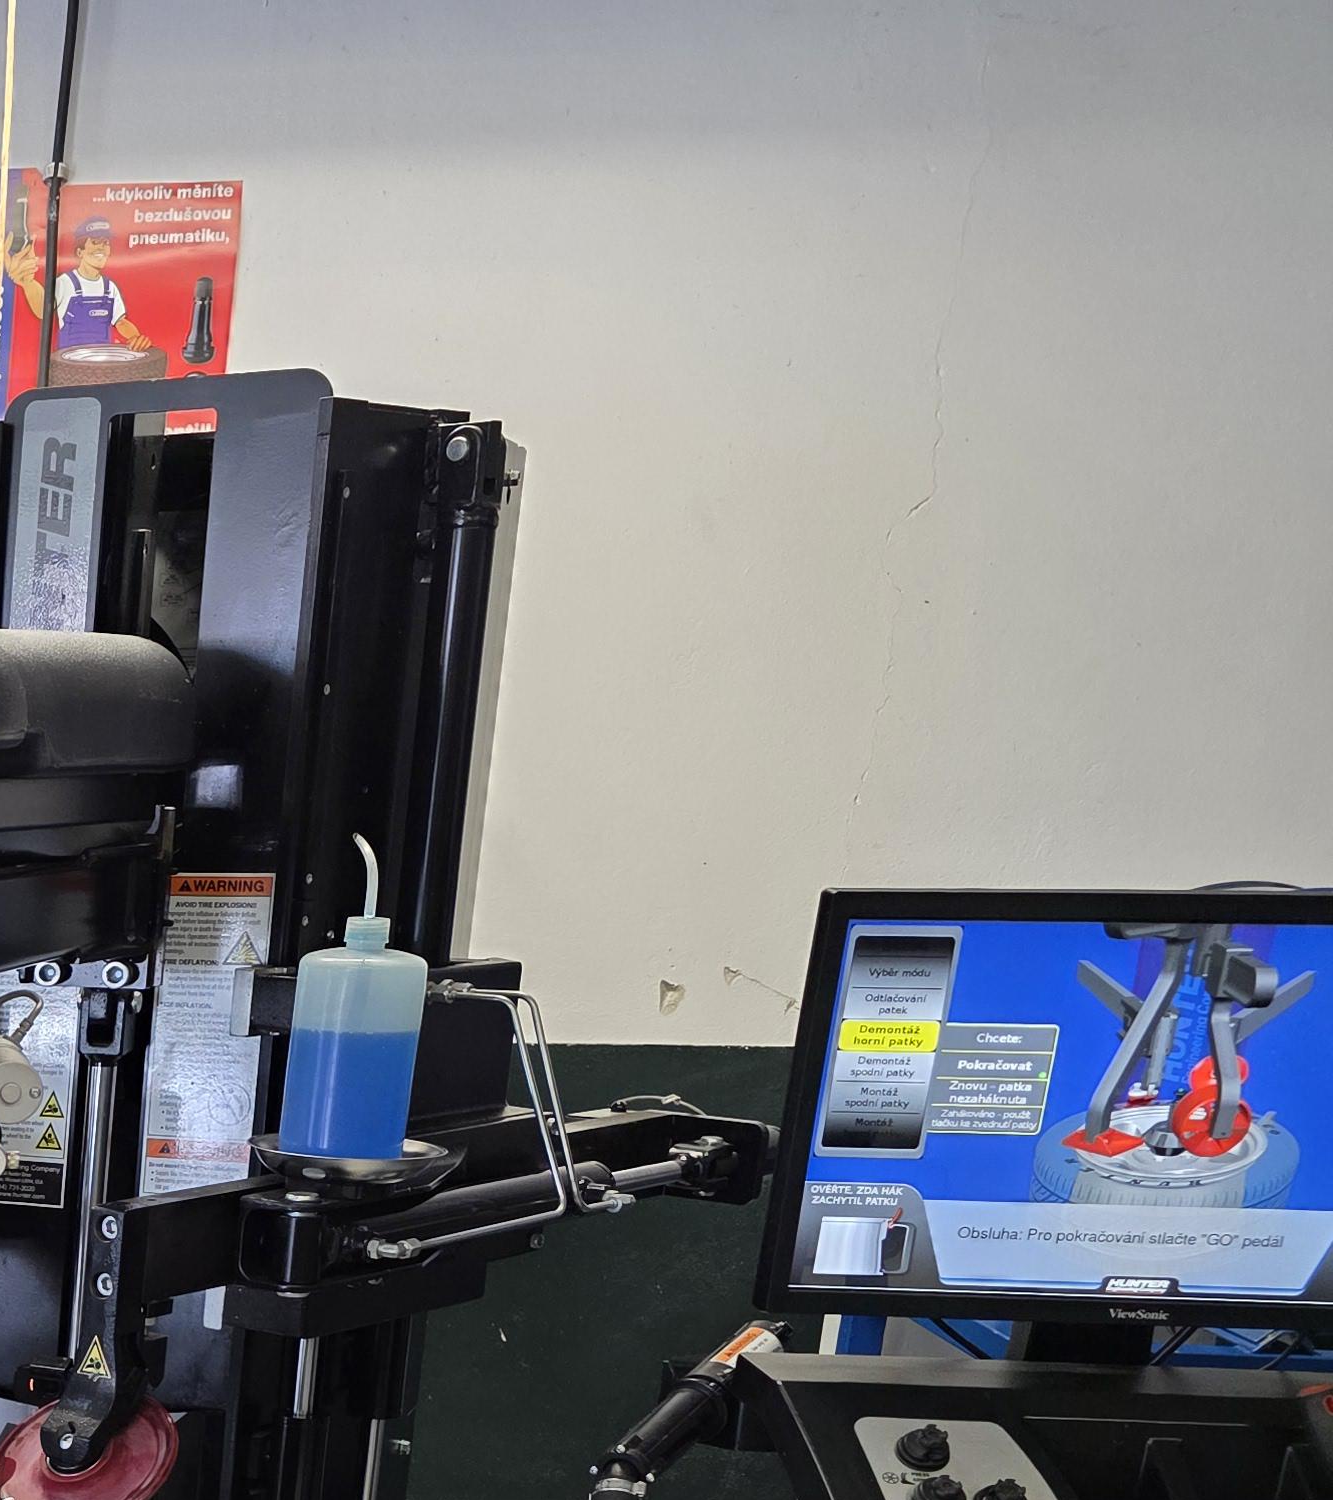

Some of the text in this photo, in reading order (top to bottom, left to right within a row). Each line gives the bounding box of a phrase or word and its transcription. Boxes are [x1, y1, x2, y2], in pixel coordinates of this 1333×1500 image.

[176, 183, 234, 200] měníte
[134, 207, 232, 223] bezdušovou
[129, 229, 230, 248] pneumatiku,
[194, 880, 264, 893] WARNING
[869, 967, 932, 979] Výběr módu
[864, 993, 928, 1003] Odtlačování
[878, 1006, 908, 1017] patek
[859, 1025, 921, 1035] Demontáž
[1164, 974, 1202, 1082] HUNTE
[853, 1036, 924, 1048] horní patky
[976, 1032, 1023, 1043] Chcete:
[858, 1056, 911, 1065] Demontáž
[957, 1060, 1033, 1071] Pokračovat
[849, 1067, 915, 1077] spodní patky
[860, 1087, 900, 1096] Montáž
[948, 1080, 988, 1091] Znovu
[998, 1082, 1033, 1093] patka
[844, 1098, 910, 1110] spodní patky
[856, 1186, 879, 1195] ZDA
[881, 1185, 903, 1196] HÁK
[811, 1195, 898, 1206] ZACHYTIL PATKU
[957, 1225, 1024, 1241] Obsluha:
[1027, 1228, 1052, 1241] Pro
[1055, 1230, 1146, 1245] pokračování
[1148, 1232, 1197, 1246] stlačte
[1241, 1235, 1285, 1249] pedál
[1109, 1278, 1171, 1290] HUNTER
[1109, 1308, 1170, 1320] ViewSonic
